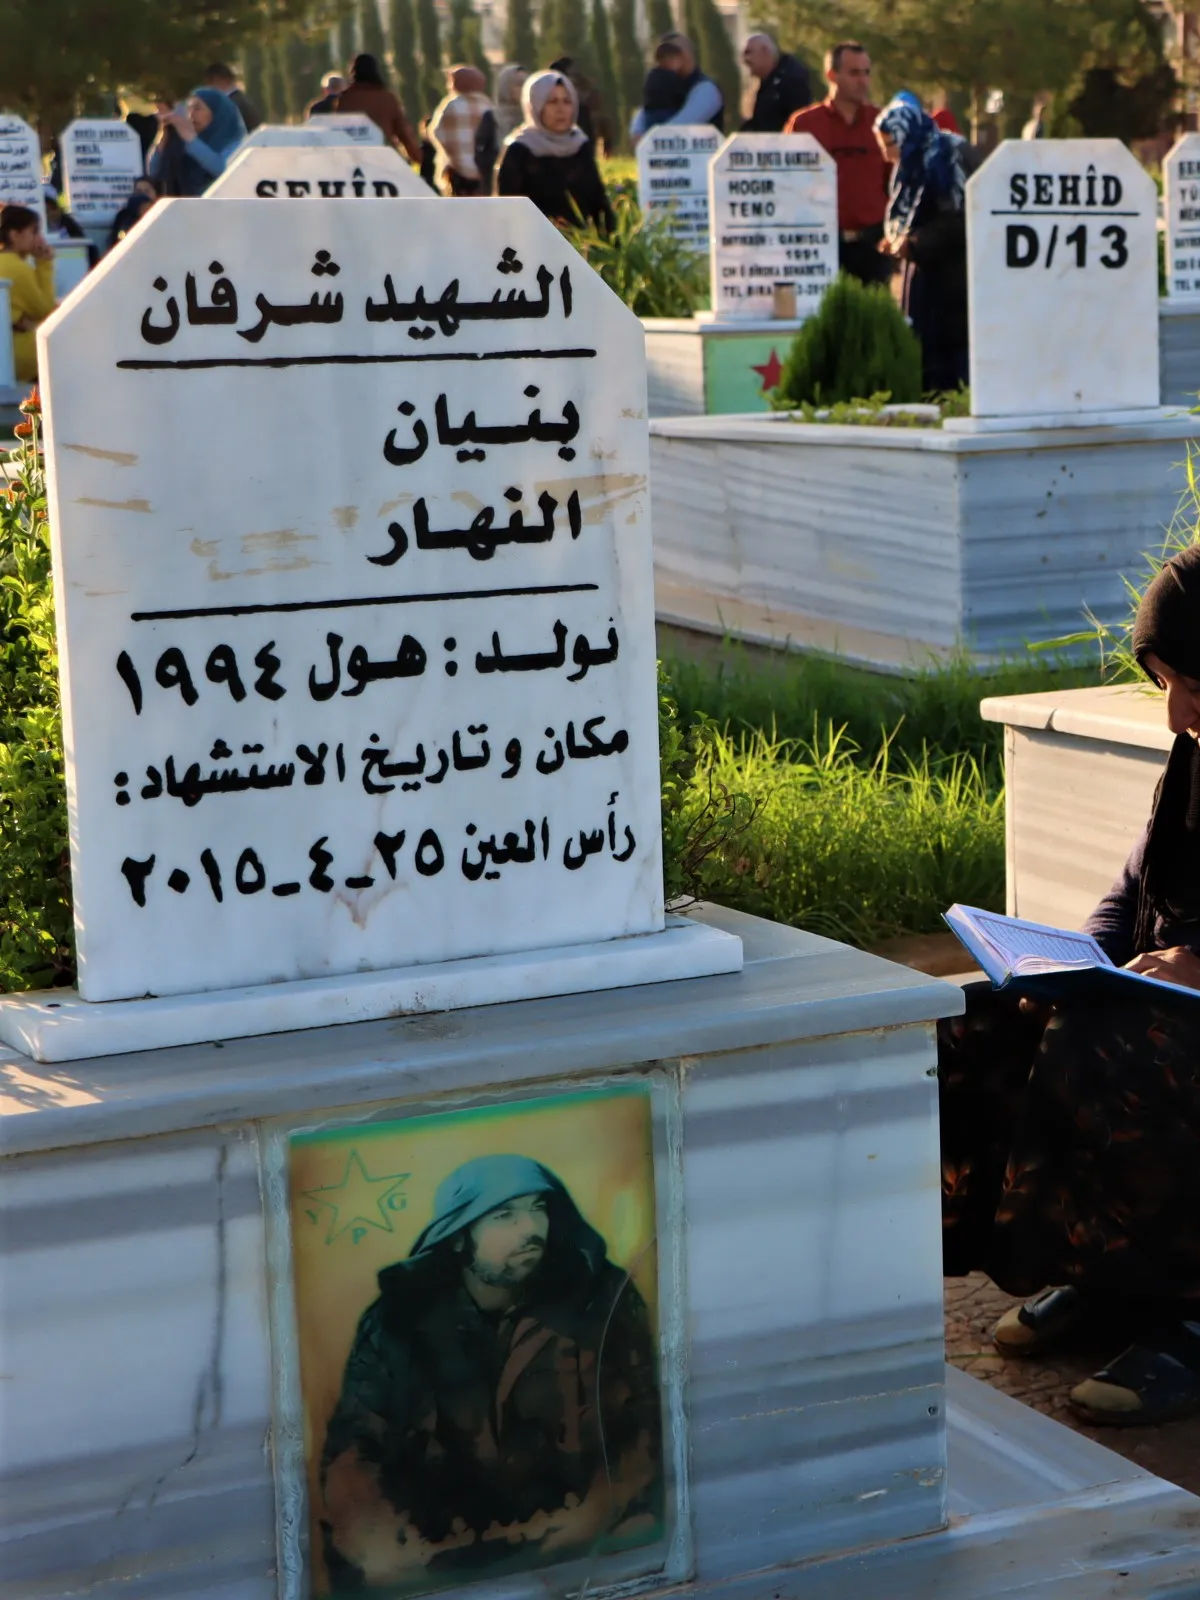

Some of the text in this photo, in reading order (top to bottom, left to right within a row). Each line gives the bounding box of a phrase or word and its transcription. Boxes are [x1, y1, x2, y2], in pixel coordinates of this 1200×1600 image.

[729, 180, 775, 196] HOGIR
[729, 202, 775, 218] TEMO
[1009, 163, 1123, 211] ŞEHÎD
[1005, 224, 1129, 270] D/13
[140, 247, 573, 345] الشهيد شرفان
[383, 385, 580, 466] بنيان
[366, 487, 582, 566] النهار
[116, 640, 287, 715] ١٩٩٤
[308, 631, 428, 702] هول
[535, 715, 629, 776] مكان
[461, 815, 550, 881] العين
[563, 791, 637, 871] رأس
